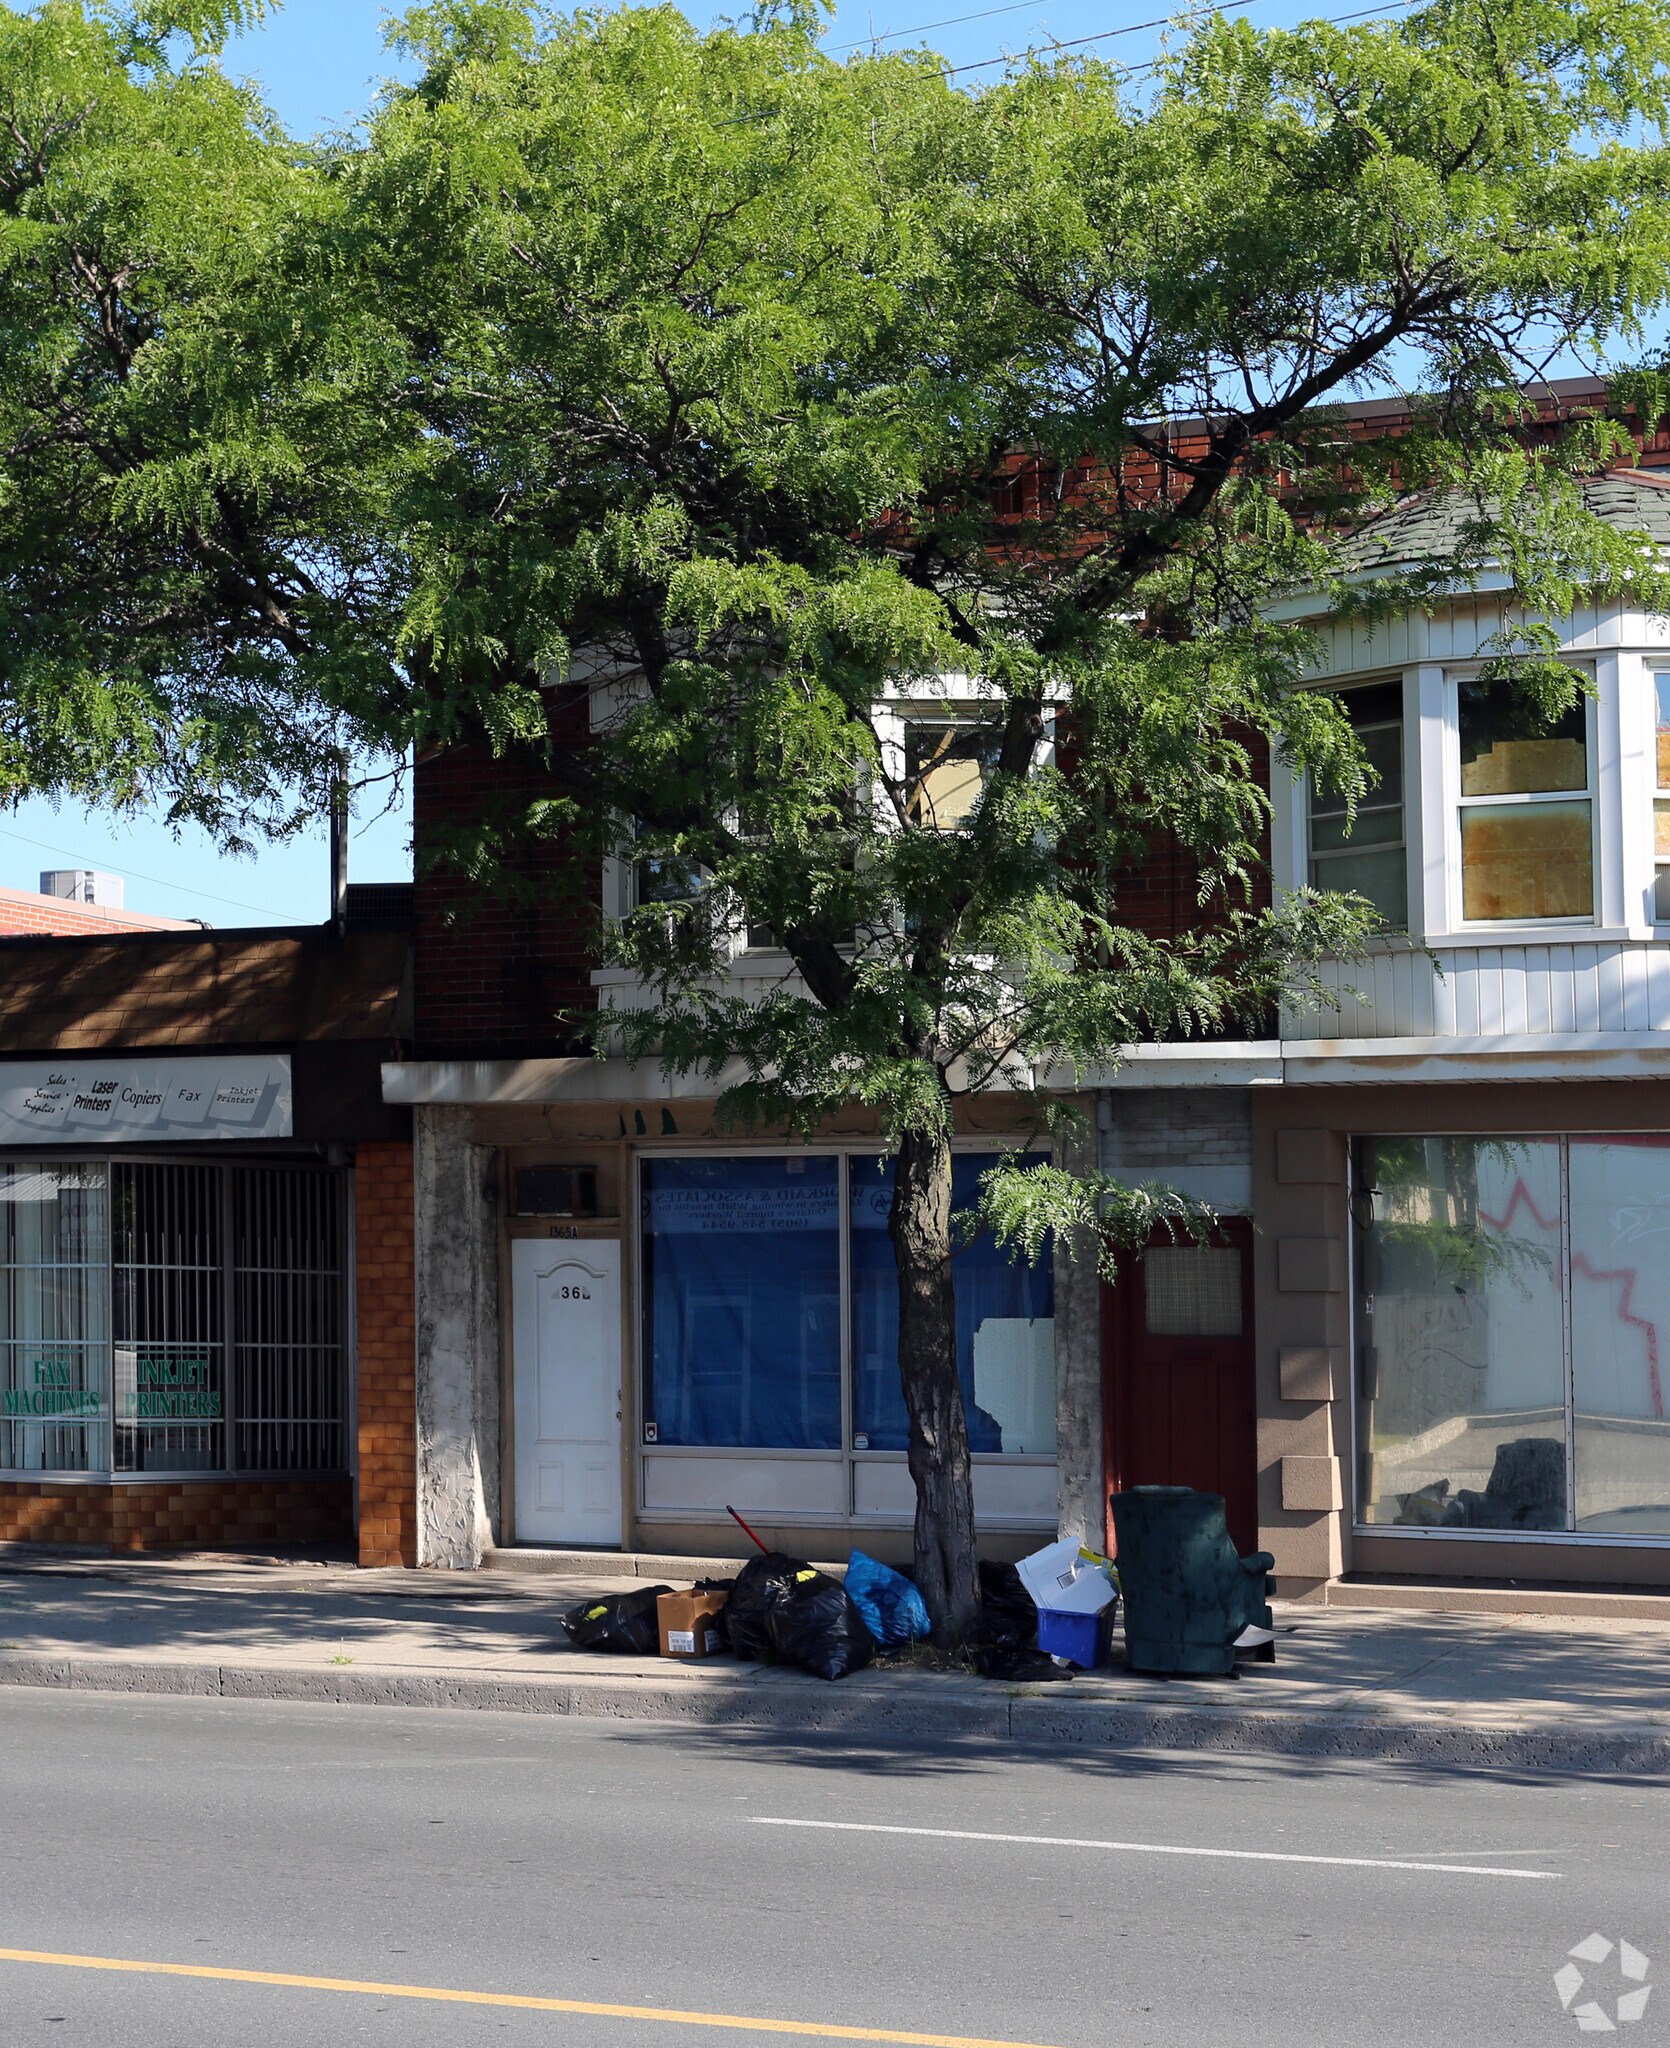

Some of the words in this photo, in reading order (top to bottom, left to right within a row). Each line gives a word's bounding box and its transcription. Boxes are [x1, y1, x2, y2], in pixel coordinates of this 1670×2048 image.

[46, 1074, 67, 1086] Sales
[91, 1080, 119, 1094] Laser
[34, 1088, 62, 1100] Service
[121, 1088, 162, 1108] Copiers
[178, 1089, 202, 1101] Fax
[229, 1087, 259, 1096] Inkjet
[23, 1099, 55, 1114] Supplies
[73, 1094, 112, 1112] Printers
[216, 1095, 255, 1104] Printers
[34, 1360, 69, 1385] FAX
[137, 1359, 208, 1384] INKJET
[4, 1390, 99, 1415] MACHINES
[124, 1391, 221, 1416] PRINTERS
